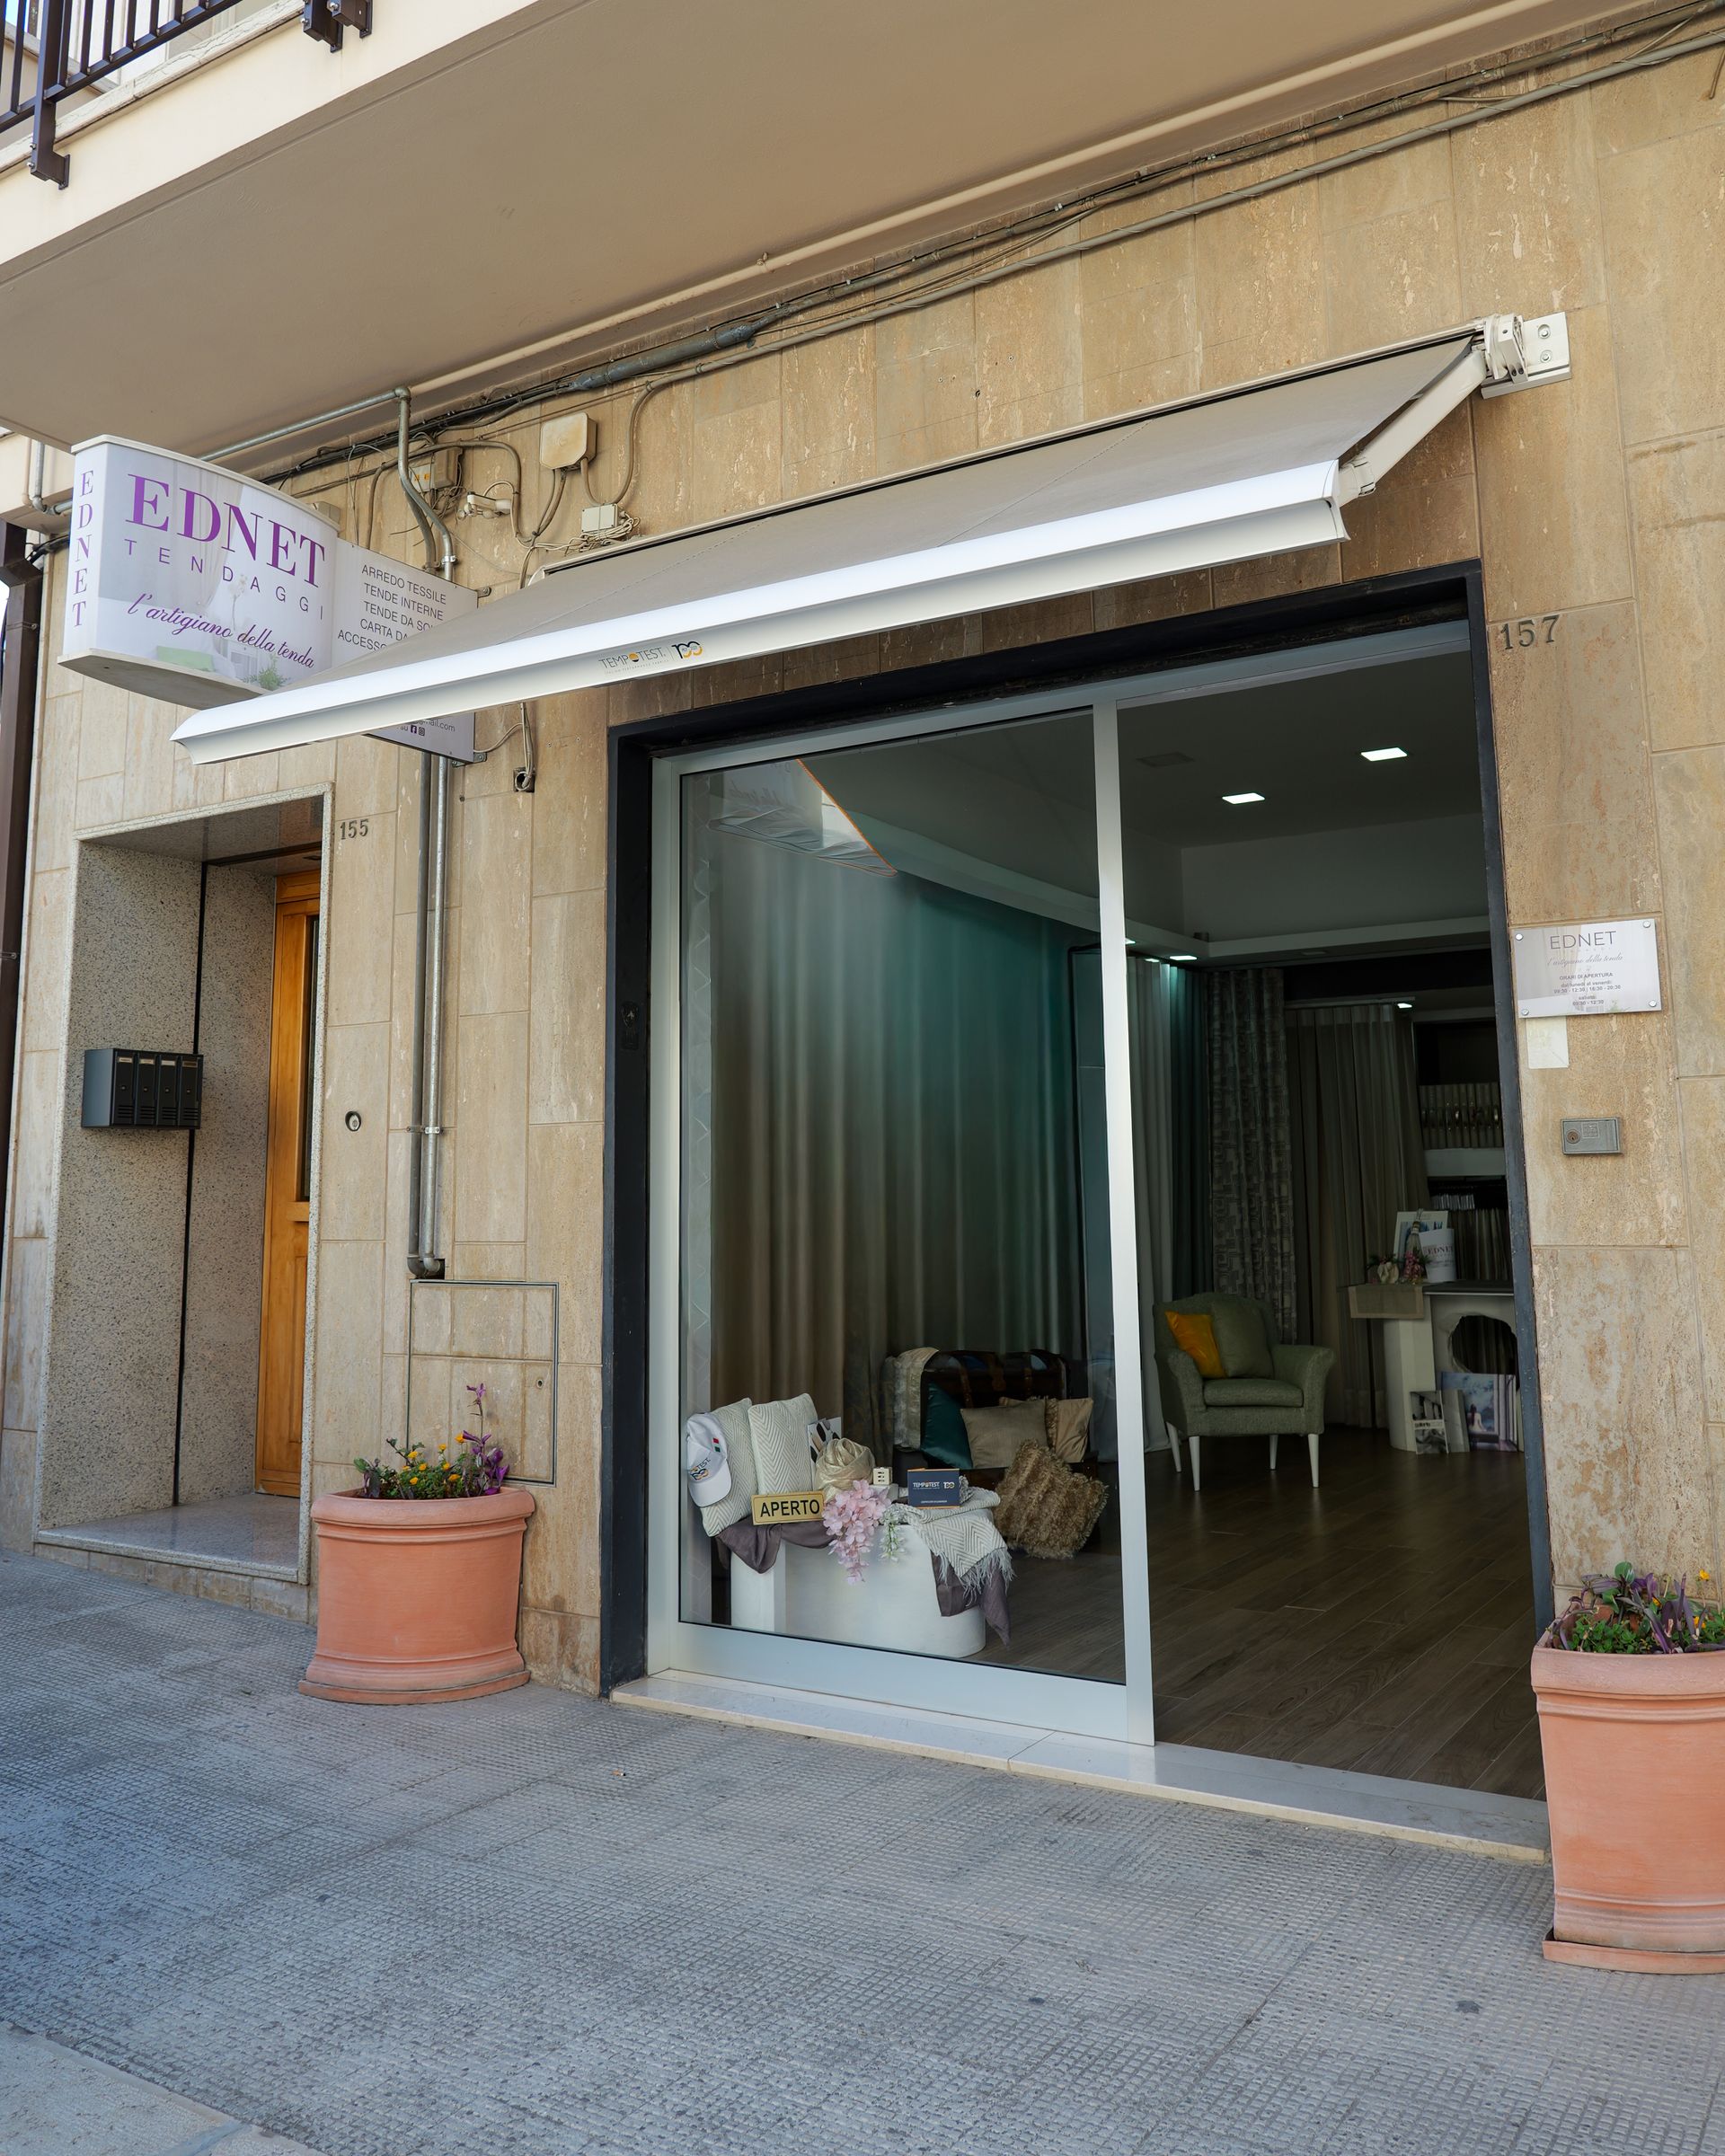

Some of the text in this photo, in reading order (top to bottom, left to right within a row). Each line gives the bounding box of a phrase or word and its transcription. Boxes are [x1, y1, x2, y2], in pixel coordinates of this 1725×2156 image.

[72, 470, 93, 626] EDNET
[126, 473, 325, 588] EDNET
[124, 539, 323, 620] TENDAGGI
[361, 564, 447, 605] ARREDO TESSILE
[364, 582, 444, 621] TENDE INTERNE
[364, 600, 398, 623] TENDE
[401, 614, 414, 628] DA
[237, 624, 275, 652] della
[277, 641, 314, 668] tenda
[360, 618, 393, 639] CARTA
[1500, 614, 1560, 649] 157
[340, 818, 369, 840] 155
[1550, 931, 1616, 950] EDNET
[760, 1499, 820, 1517] APERTO
